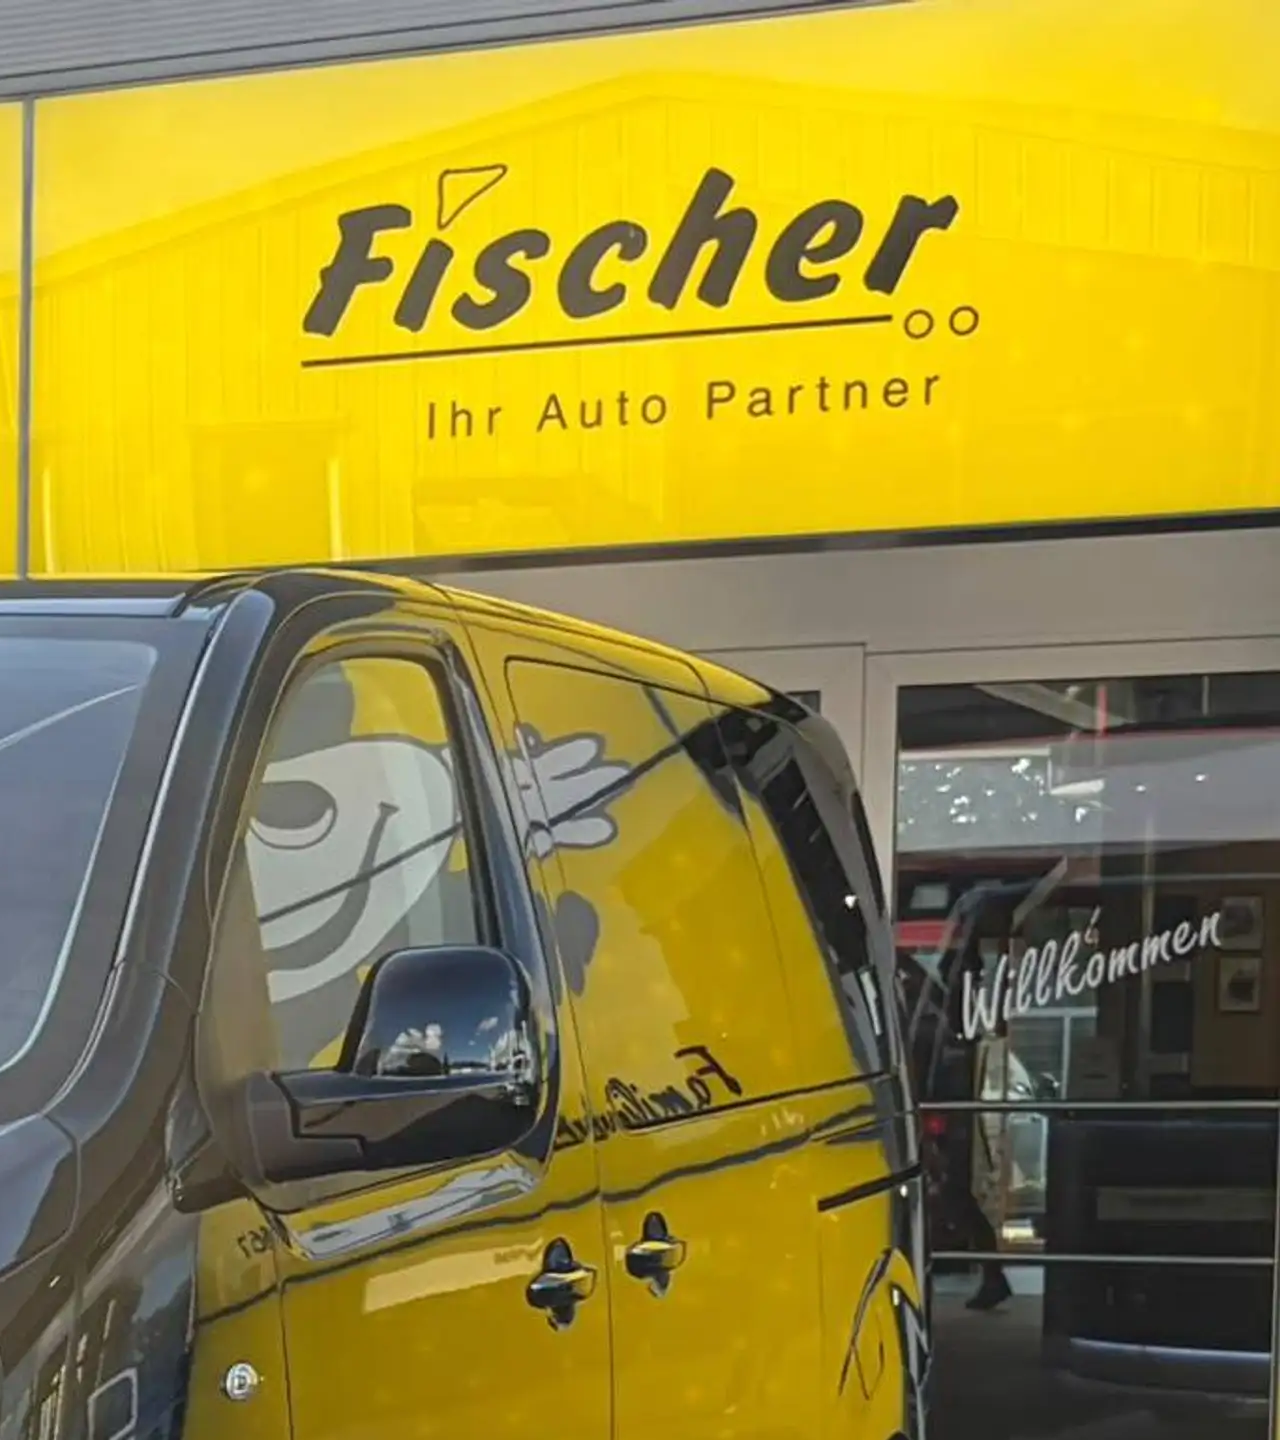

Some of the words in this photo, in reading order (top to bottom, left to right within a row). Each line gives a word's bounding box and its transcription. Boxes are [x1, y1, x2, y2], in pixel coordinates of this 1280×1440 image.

[302, 166, 958, 336] Fischer
[426, 401, 503, 440] Ihr
[535, 392, 668, 434] Auto
[706, 374, 942, 420] Partner
[962, 910, 1222, 1041] Willkommen
